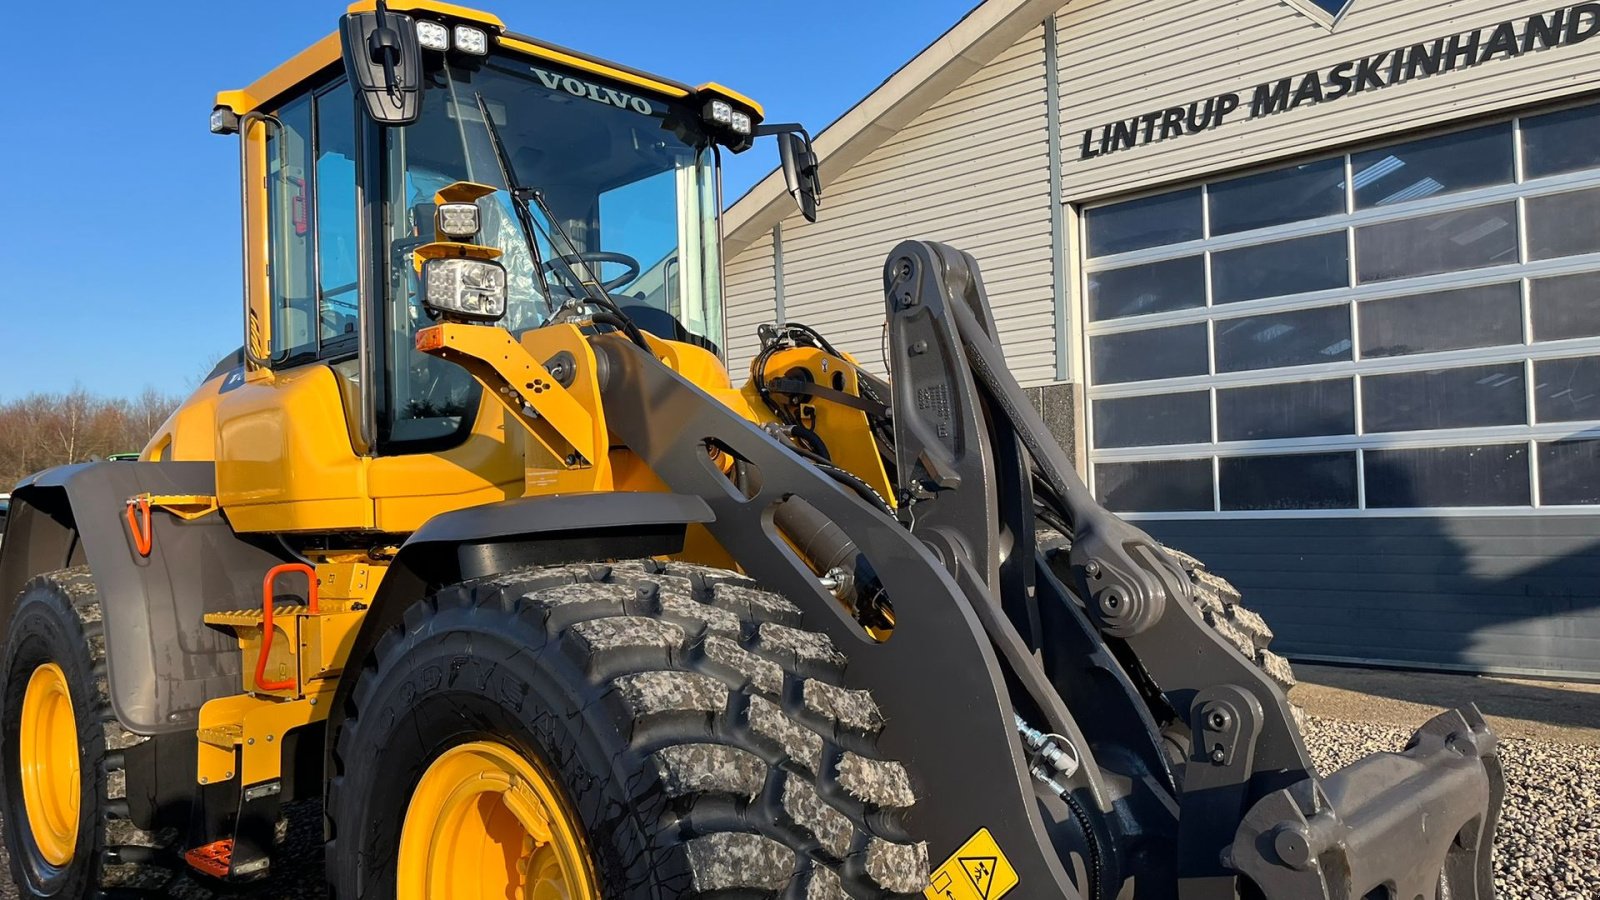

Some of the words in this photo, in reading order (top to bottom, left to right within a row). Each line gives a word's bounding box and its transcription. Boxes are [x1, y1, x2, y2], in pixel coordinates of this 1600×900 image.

[530, 67, 653, 115] VOLVO
[1080, 92, 1240, 159] LINTRUP
[1250, 3, 1600, 119] MASKINHAND
